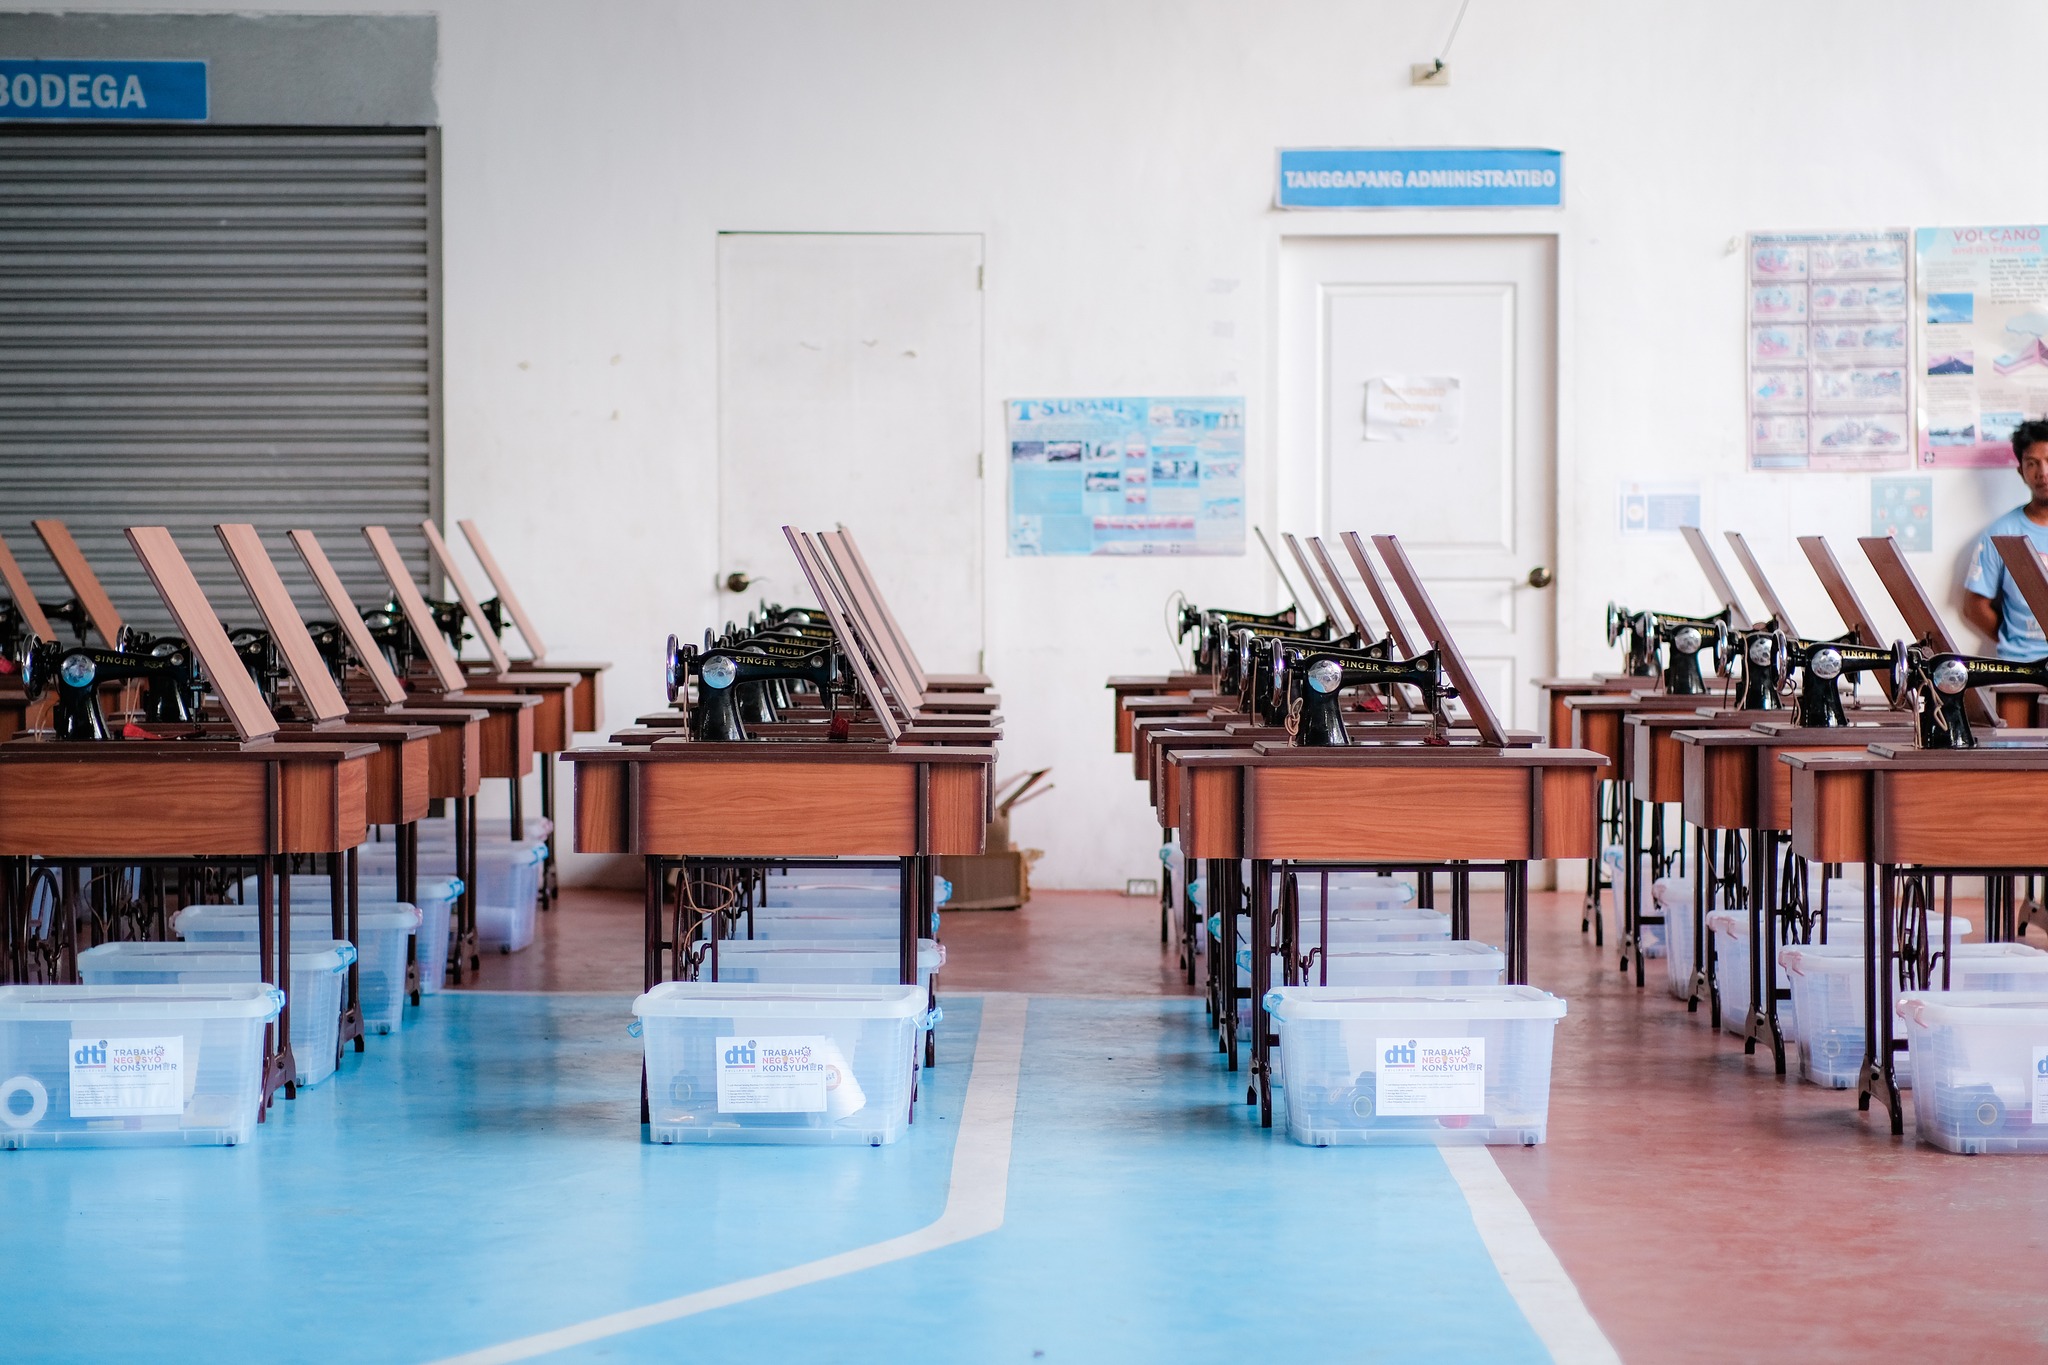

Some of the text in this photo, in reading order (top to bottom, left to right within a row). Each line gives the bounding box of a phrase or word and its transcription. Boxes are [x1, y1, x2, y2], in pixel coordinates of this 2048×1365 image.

[1285, 170, 1556, 188] TANGGAPANG ADMINISTRATIBO
[1953, 227, 2041, 241] VOLCANO
[785, 638, 818, 647] SINGER
[768, 646, 805, 656] SINGER
[1841, 650, 1877, 660] SINGER
[95, 655, 136, 666] SINGER
[735, 656, 776, 666] SINGER
[1339, 660, 1380, 671] SINGER
[1969, 662, 2011, 672] SINGER
[74, 1040, 108, 1064] dti
[725, 1040, 757, 1064] dti
[1385, 1040, 1417, 1064] dti
[114, 1062, 177, 1072] KONSYUMR
[763, 1063, 824, 1072] KONSYUMR
[1422, 1063, 1483, 1071] KONSYUMR
